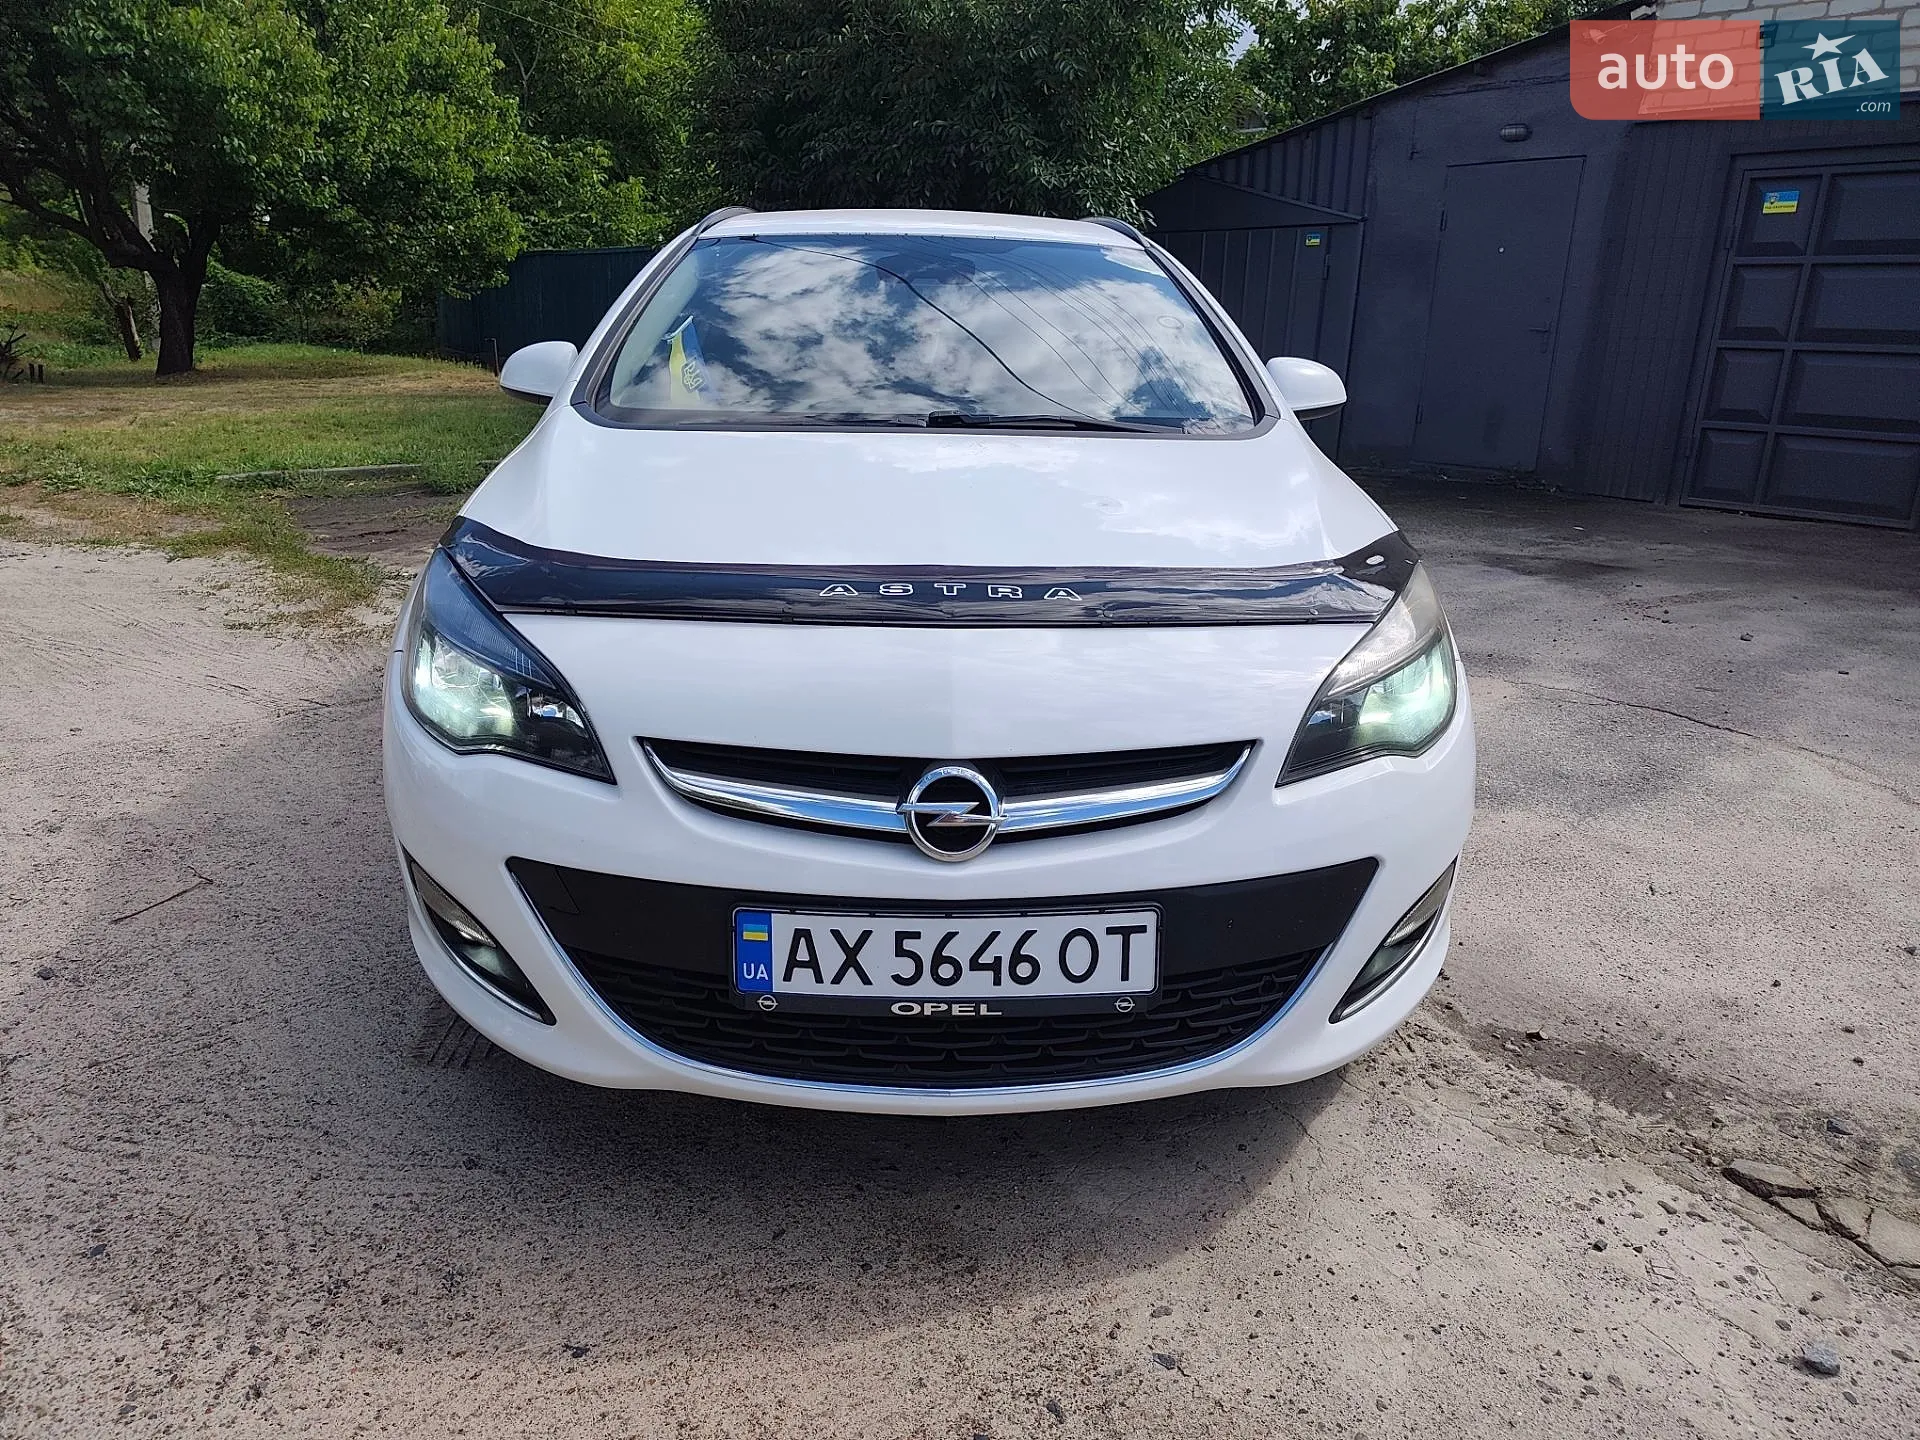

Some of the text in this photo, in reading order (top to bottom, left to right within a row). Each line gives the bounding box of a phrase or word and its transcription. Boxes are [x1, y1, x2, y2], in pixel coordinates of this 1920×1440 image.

[819, 583, 1083, 600] ASTRA
[782, 924, 1148, 987] AX 5646 OT
[743, 961, 769, 981] UA
[890, 1001, 1003, 1016] OPEL
